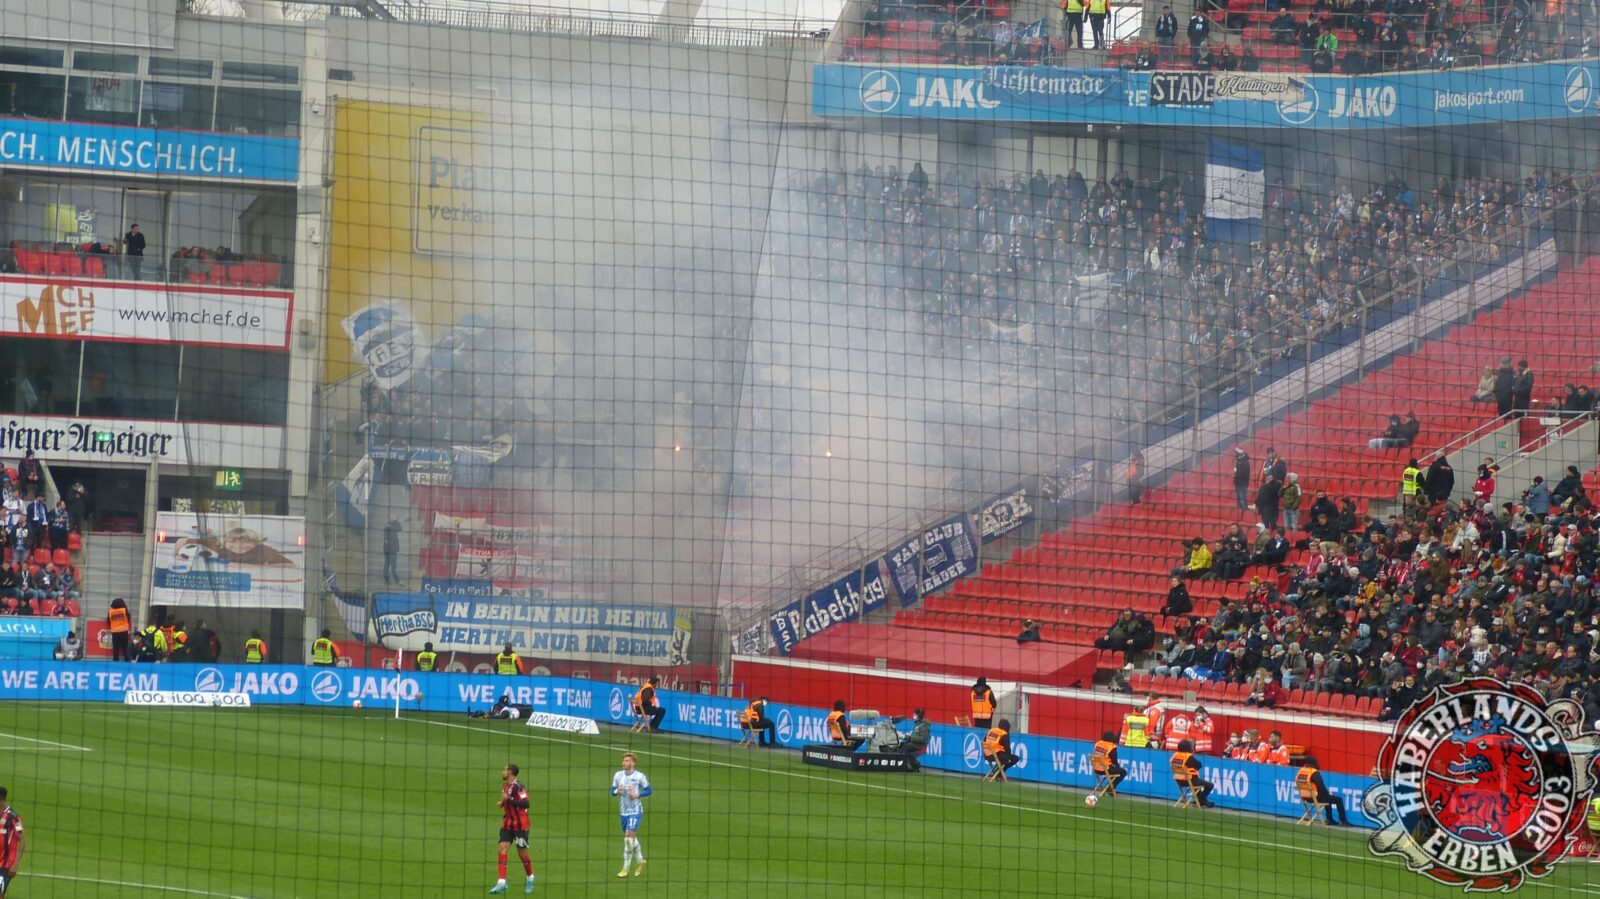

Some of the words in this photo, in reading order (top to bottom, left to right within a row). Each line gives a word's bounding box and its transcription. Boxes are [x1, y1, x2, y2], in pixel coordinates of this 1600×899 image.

[1152, 72, 1214, 102] STADE
[1434, 88, 1523, 112] jakosport.com
[1328, 85, 1397, 118] JAKO
[0, 131, 44, 161] CH.
[57, 136, 244, 174] MENSCHLICH.
[118, 307, 261, 328] www.mchef.de
[68, 422, 173, 457] Anzeiger
[892, 539, 921, 568] FAN
[924, 522, 964, 547] CLUB
[445, 602, 470, 620] IN
[472, 603, 549, 623] BERLIN
[552, 606, 600, 626] NUR
[605, 608, 668, 629] HERTHA
[788, 575, 887, 641] Babelsberg
[439, 626, 525, 649] HERTHA
[531, 631, 582, 652] NUR
[585, 633, 612, 654] IN
[615, 635, 668, 657] BERLIN
[2, 670, 38, 689] WE
[43, 671, 91, 690] ARE
[95, 672, 159, 692] TEAM
[229, 670, 298, 695] JAKO
[348, 675, 419, 701] JAKO
[458, 684, 495, 704] WE
[502, 687, 551, 707] ARE
[553, 688, 592, 709] TEAM
[678, 703, 696, 723] WE
[700, 706, 722, 728] ARE
[1052, 749, 1075, 774] WE
[629, 818, 637, 827] 17
